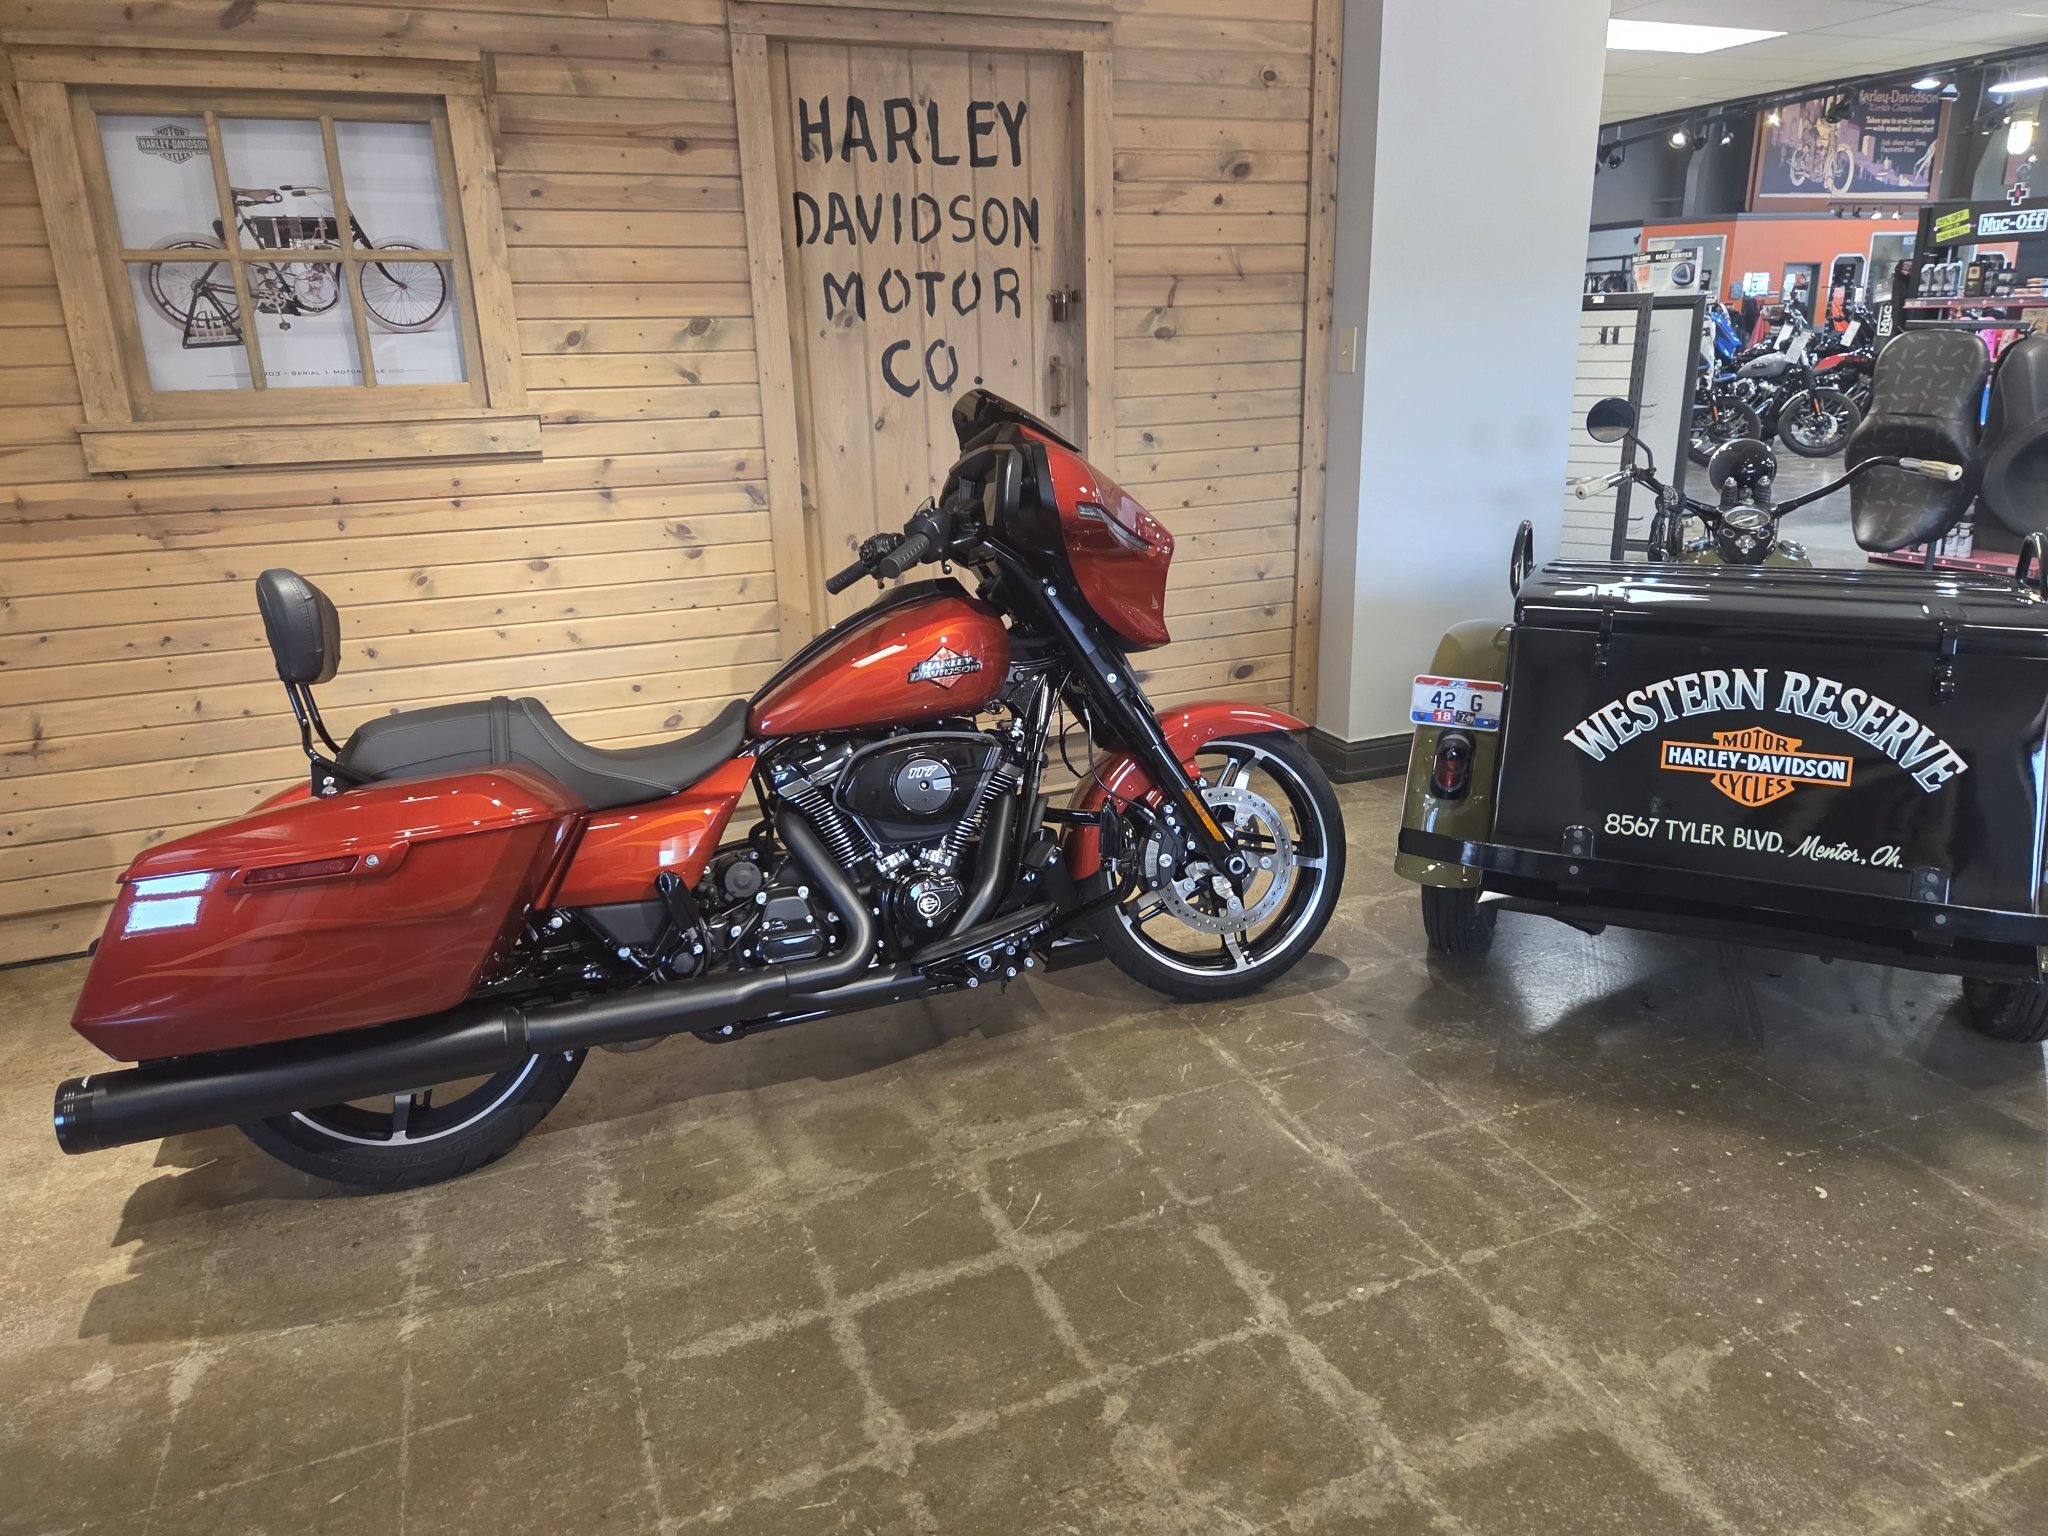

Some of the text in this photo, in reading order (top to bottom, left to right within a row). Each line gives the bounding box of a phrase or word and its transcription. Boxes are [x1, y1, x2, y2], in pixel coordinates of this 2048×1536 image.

[156, 126, 185, 136] MOTOR
[798, 95, 1027, 168] HARLEY
[140, 138, 208, 150] HARLEY-DAVIDSON
[162, 151, 190, 161] CYCLES
[793, 191, 1039, 248] DAVIDSON
[1982, 211, 2045, 232] Muc-Off
[823, 267, 1021, 322] MOTOR
[333, 368, 386, 376] MOTORLE
[881, 339, 984, 398] CO.
[909, 664, 980, 682] DAVIDSON
[921, 657, 973, 673] HARLEY
[1431, 691, 1483, 713] 42 G
[1435, 712, 1451, 721] 18
[1563, 668, 1969, 793] WESTERN RESERVE
[1723, 730, 1789, 752] MOTOR
[1668, 746, 1846, 780] HARLEY-DAVIDSON
[1718, 773, 1788, 803] CYCLES
[1604, 813, 1904, 869] 8567 TYLER BLVD. Mentor, Oh.
